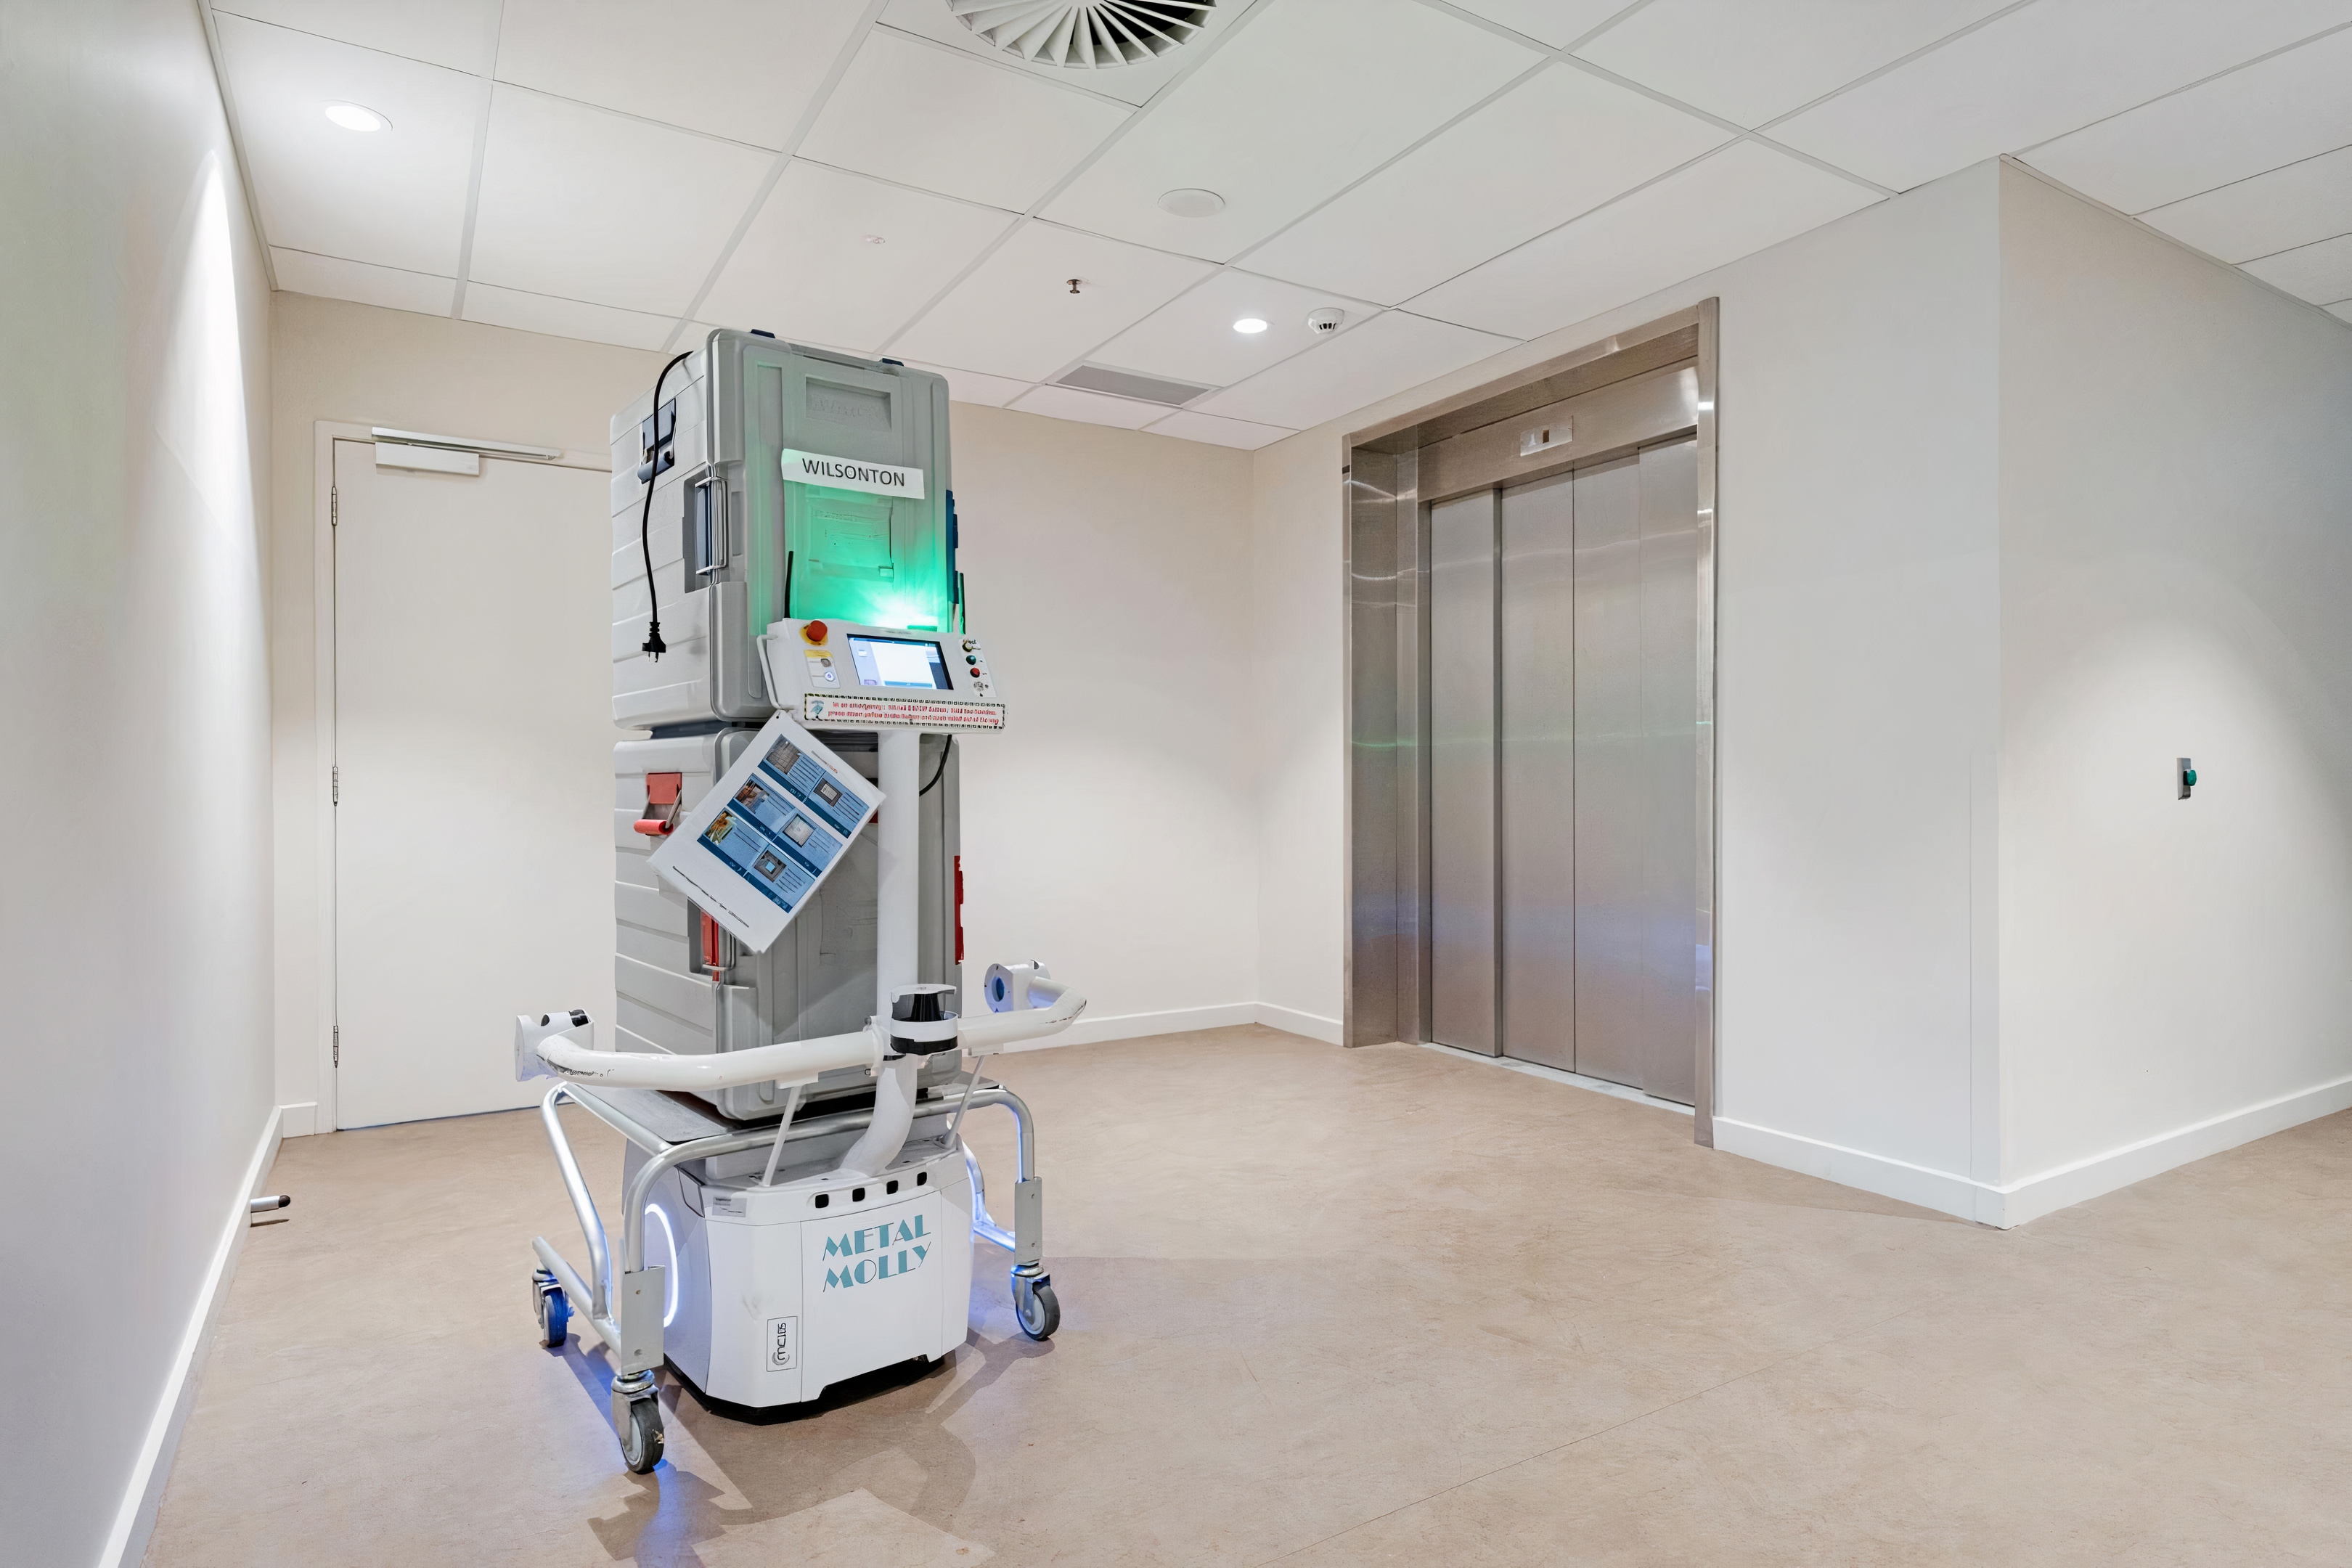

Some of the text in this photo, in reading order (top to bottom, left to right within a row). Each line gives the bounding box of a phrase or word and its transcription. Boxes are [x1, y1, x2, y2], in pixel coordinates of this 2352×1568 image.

[802, 457, 905, 487] WILSONTON
[822, 1214, 931, 1261] METAL
[822, 1241, 931, 1293] MOLLY
